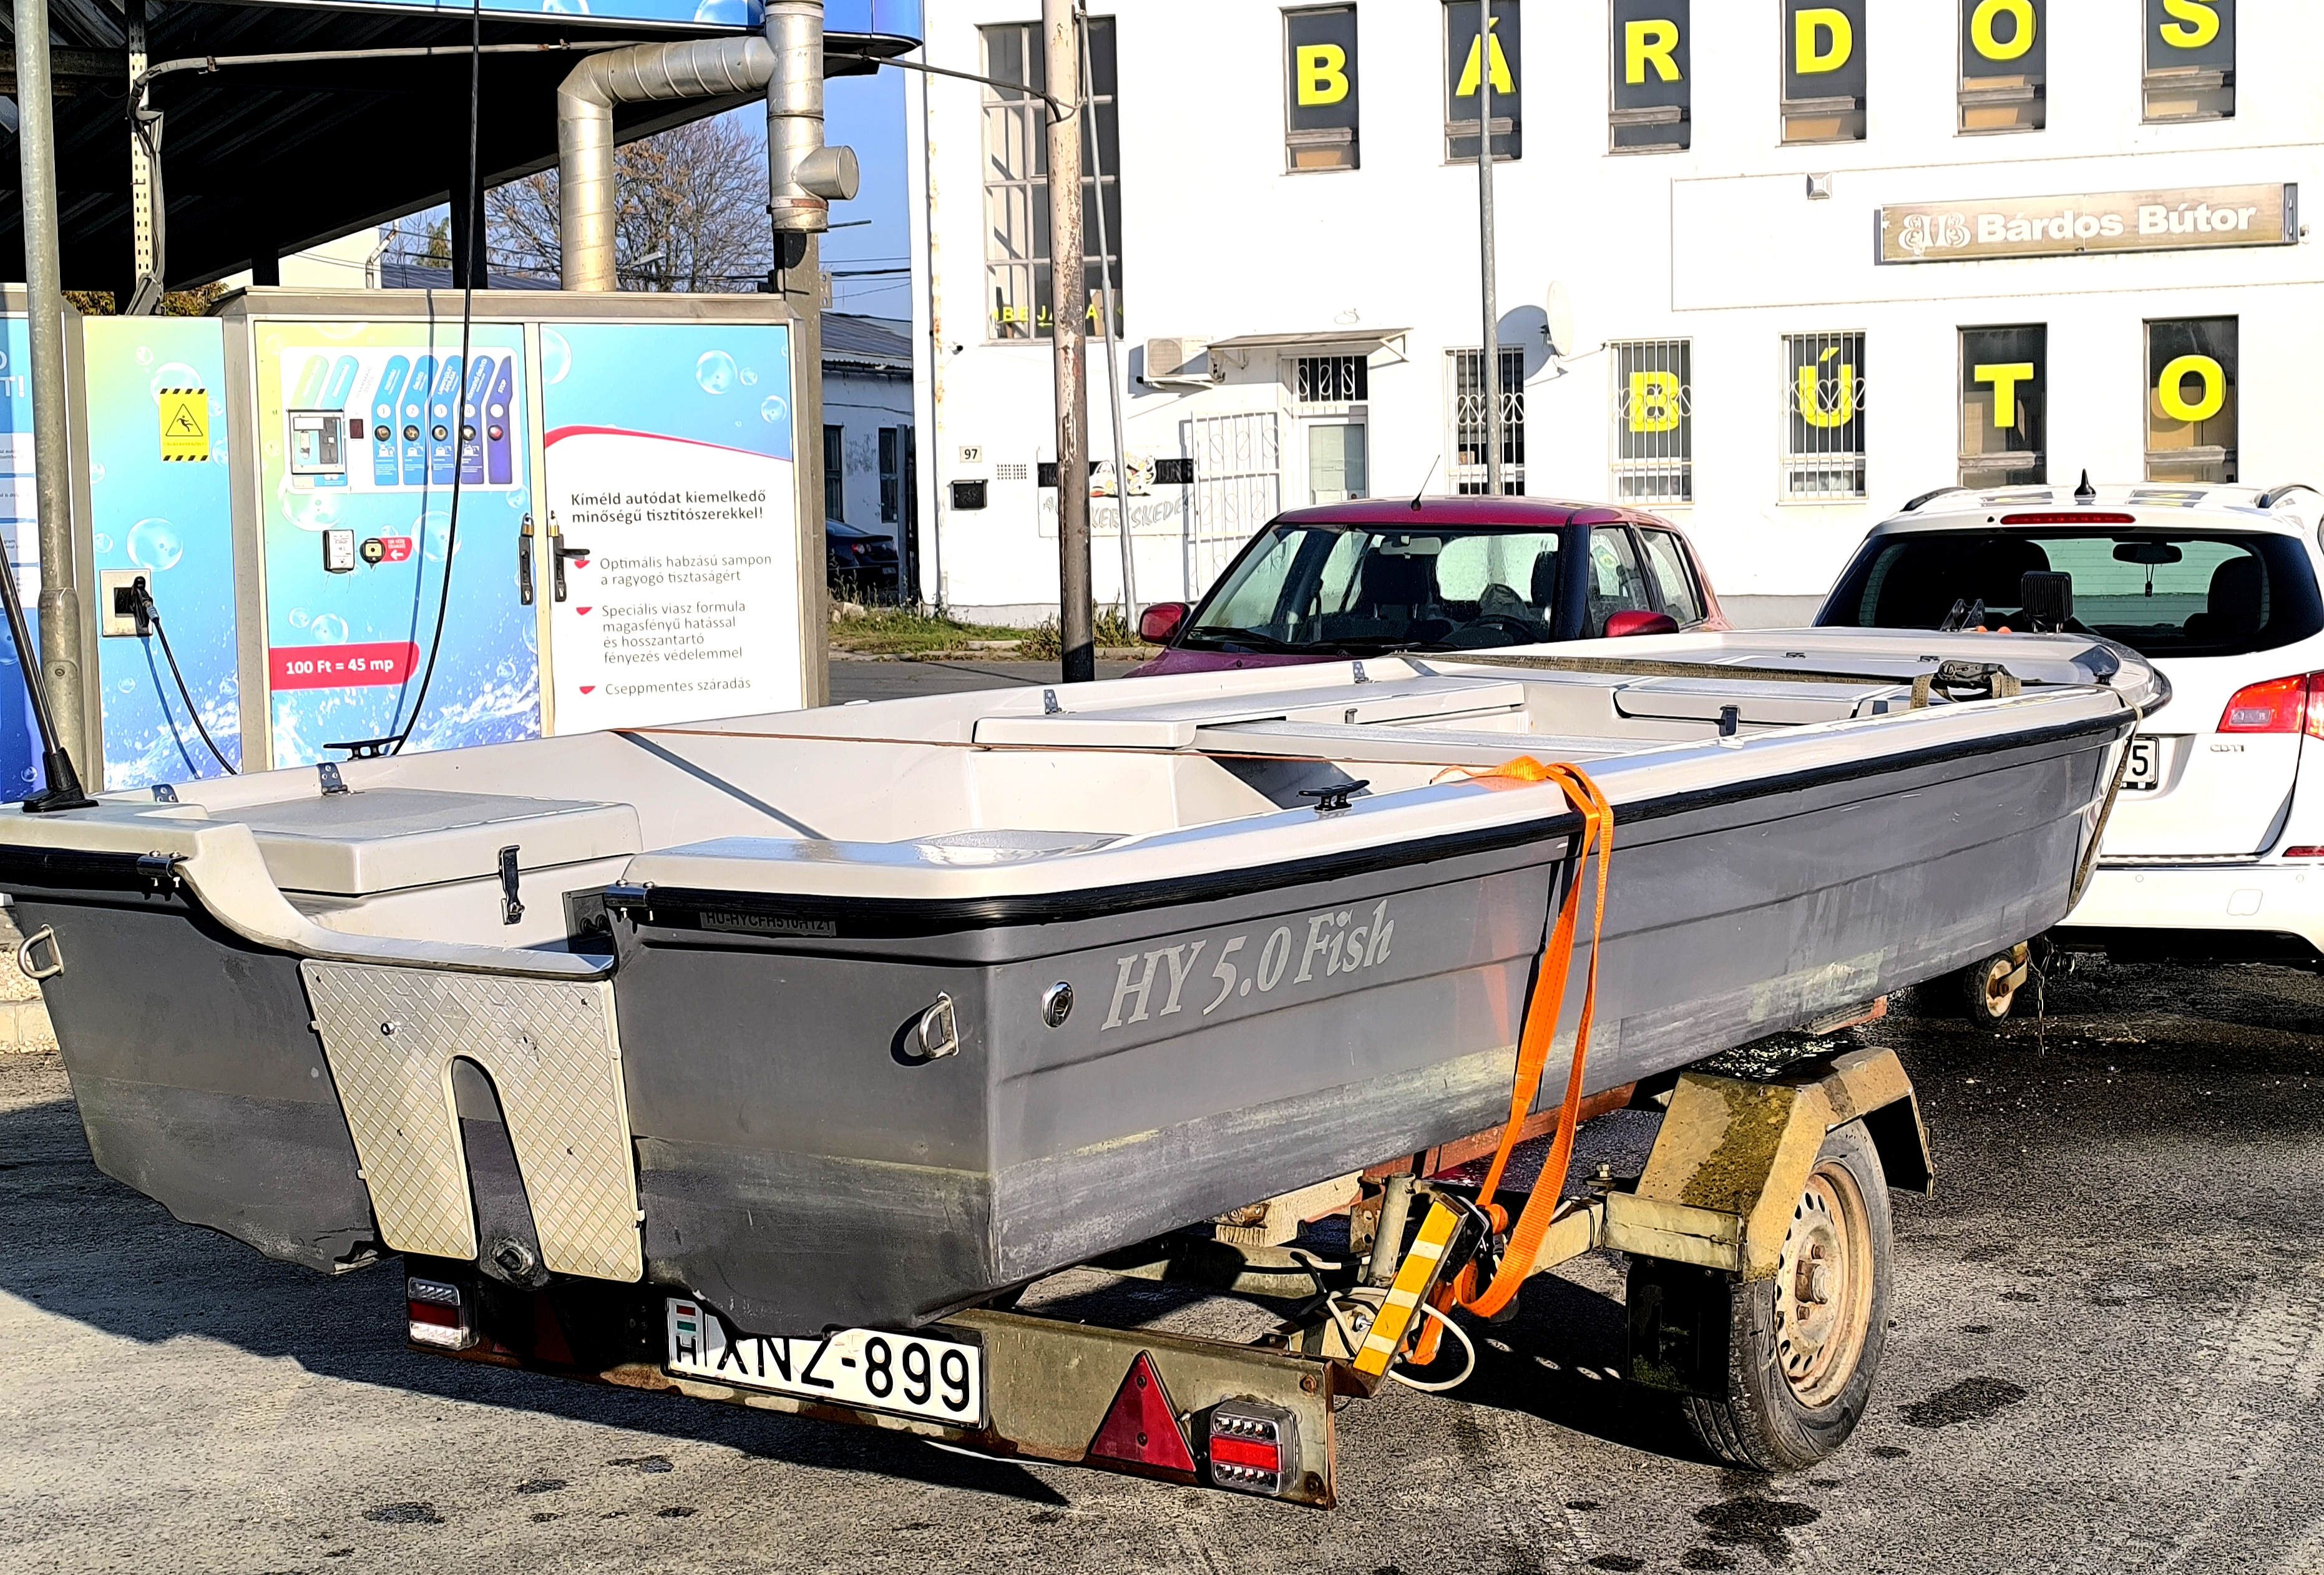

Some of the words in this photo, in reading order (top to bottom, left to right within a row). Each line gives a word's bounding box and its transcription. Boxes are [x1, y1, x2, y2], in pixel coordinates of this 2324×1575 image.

[1977, 210, 2124, 243] Bárdos
[2137, 203, 2258, 236] Bútor
[497, 378, 507, 394] STOP
[964, 448, 978, 459] 97
[572, 493, 621, 506] Kíméld
[626, 491, 681, 504] autódat
[686, 489, 766, 503] kiemelkedő
[572, 509, 642, 524] minőségű
[647, 506, 763, 521] tisztítószerekkel!
[600, 556, 662, 571] Optimális
[666, 554, 718, 567] habzású
[721, 556, 771, 567] sampon
[601, 576, 607, 585] a
[613, 571, 664, 587] ragyogó
[668, 570, 741, 584] tisztaságért
[602, 603, 658, 619] Speciális
[662, 603, 691, 614] viasz
[696, 600, 745, 613] formula
[603, 618, 680, 634] magasfényű
[685, 616, 736, 629] hatással
[603, 635, 617, 648] és
[622, 632, 705, 647] hosszantartó
[605, 650, 660, 665] fényezés
[664, 646, 742, 661] védelemmel
[286, 661, 313, 675] 100
[317, 660, 332, 673] Ft
[348, 658, 366, 671] 45
[370, 659, 394, 672] mp
[605, 682, 693, 697] Cseppmentes
[698, 677, 751, 690] száradás
[2210, 743, 2245, 753] CDTI
[1101, 939, 1207, 1032] HY
[1203, 926, 1292, 1016] 5.0
[1293, 899, 1395, 984] Fish
[717, 1336, 970, 1413] XNZ-899
